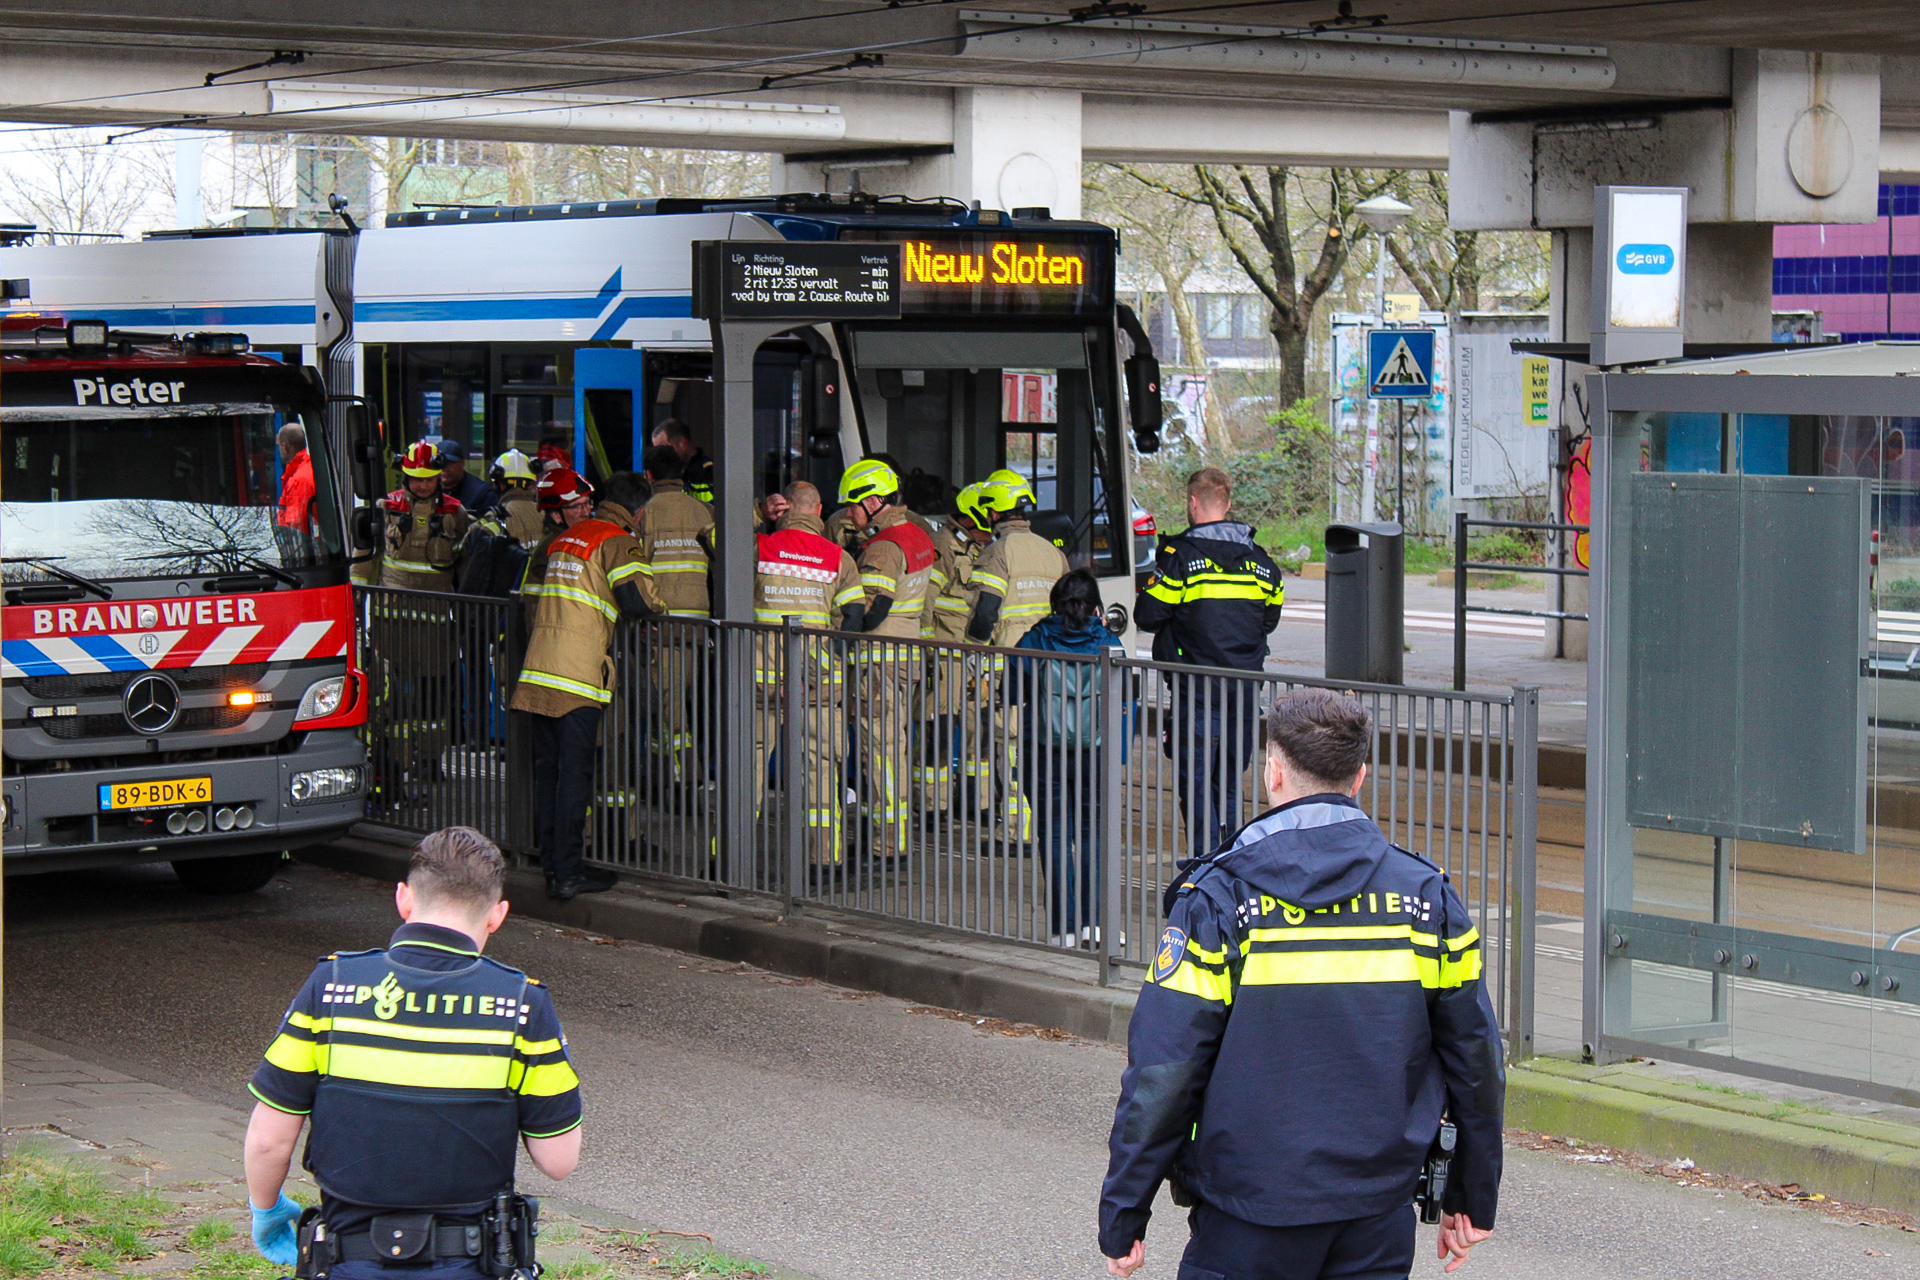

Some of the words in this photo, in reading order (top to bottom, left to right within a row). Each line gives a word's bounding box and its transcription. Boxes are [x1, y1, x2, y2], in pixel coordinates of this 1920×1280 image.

[731, 254, 746, 264] Lijn
[754, 254, 785, 265] Richting
[860, 255, 889, 264] Vertrek
[744, 265, 751, 276] 2
[753, 265, 782, 276] Nieuw
[784, 265, 819, 277] Sloten
[872, 267, 889, 277] min
[905, 241, 983, 284] Nieuw
[991, 242, 1084, 285] Sloten
[1645, 254, 1666, 265] GVB
[744, 278, 751, 288] 2
[753, 278, 768, 289] rit
[770, 278, 798, 289] 17:35
[800, 278, 839, 289] vervalt
[872, 280, 889, 289] min
[757, 291, 770, 302] by
[773, 291, 795, 302] tram
[810, 291, 842, 302] Cause:
[845, 292, 874, 302] Route
[1462, 347, 1471, 409] MUSEUM
[73, 377, 186, 405] Pieter
[1461, 412, 1471, 486] STEDELIJK
[764, 585, 824, 597] BRANDWEE
[33, 598, 258, 635] BRANDWEER
[116, 782, 207, 805] 89-BDK-6
[355, 985, 497, 1020] POLITIE
